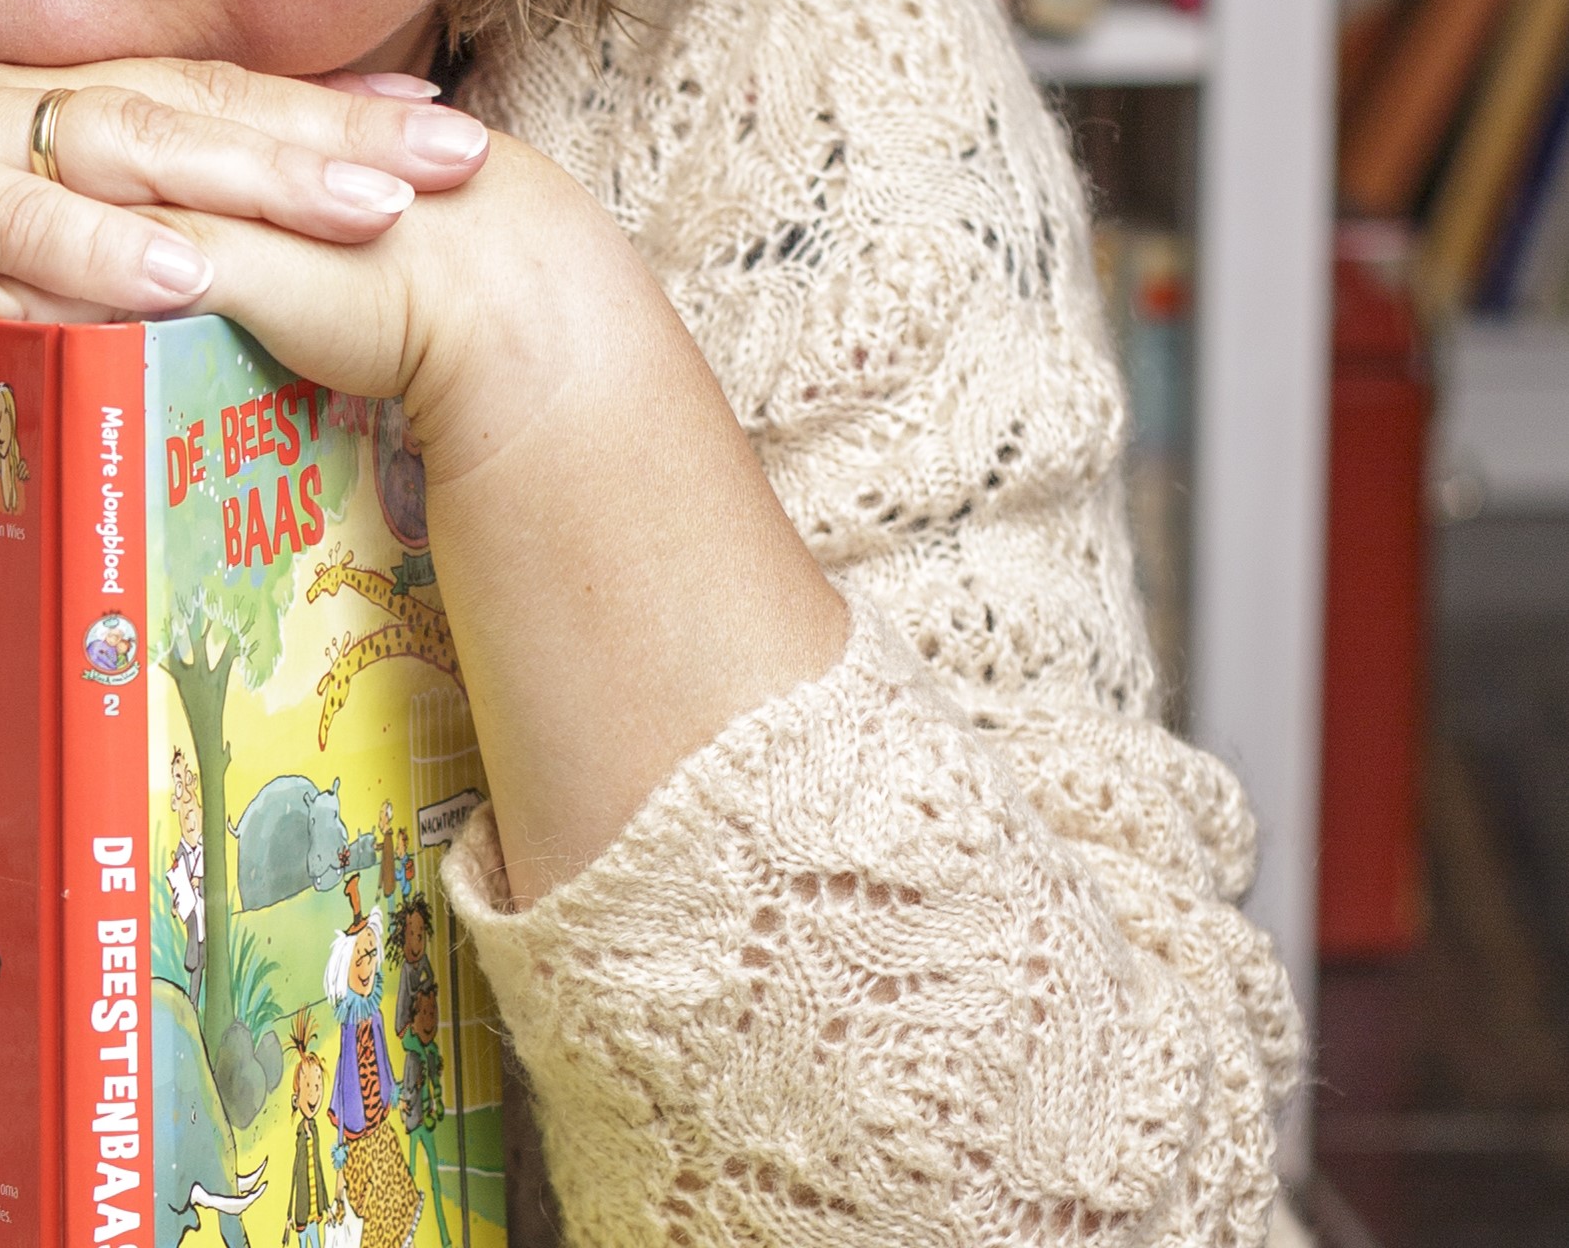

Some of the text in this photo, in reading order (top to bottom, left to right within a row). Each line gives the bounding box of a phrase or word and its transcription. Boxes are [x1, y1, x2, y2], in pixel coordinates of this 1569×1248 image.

[166, 418, 206, 507] DE
[95, 406, 126, 594] Marte Jongbloed
[222, 464, 326, 570] BAAS
[6, 523, 26, 541] Wies
[102, 692, 121, 717] 2
[92, 836, 136, 893] DE
[0, 1183, 19, 1200] oma
